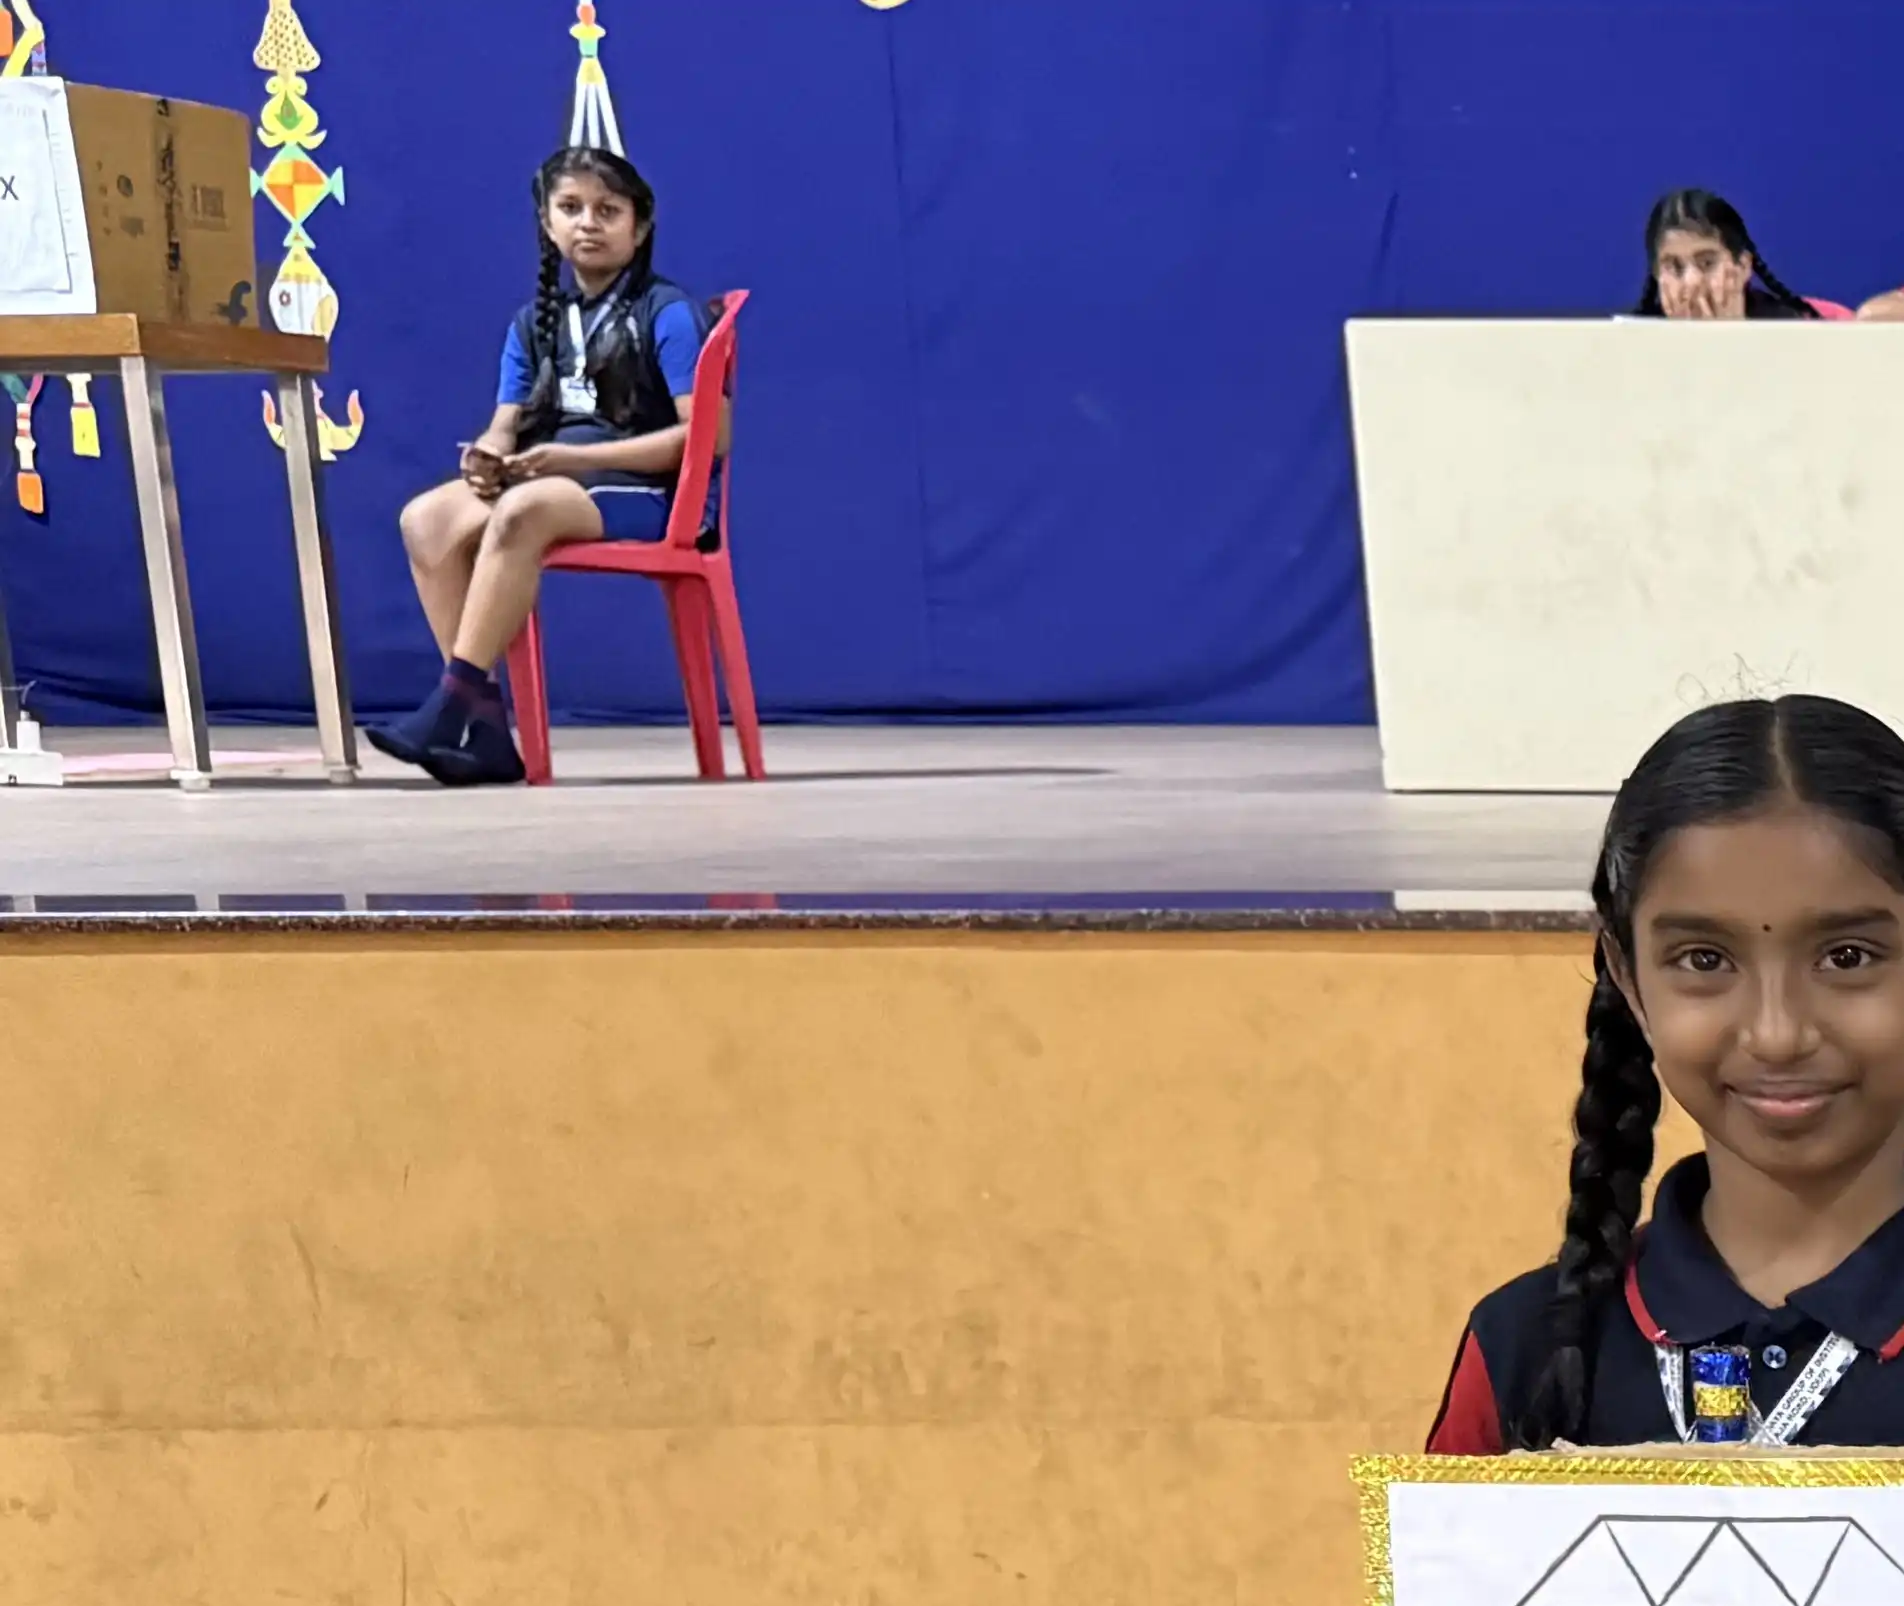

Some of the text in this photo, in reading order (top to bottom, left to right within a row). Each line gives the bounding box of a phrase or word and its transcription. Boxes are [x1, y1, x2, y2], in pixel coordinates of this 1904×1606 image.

[1778, 1378, 1808, 1411] GROUP
[1801, 1365, 1817, 1381] OF
[1811, 1333, 1840, 1368] INSTITU
[1784, 1365, 1830, 1423] ROAD, UDUPI
